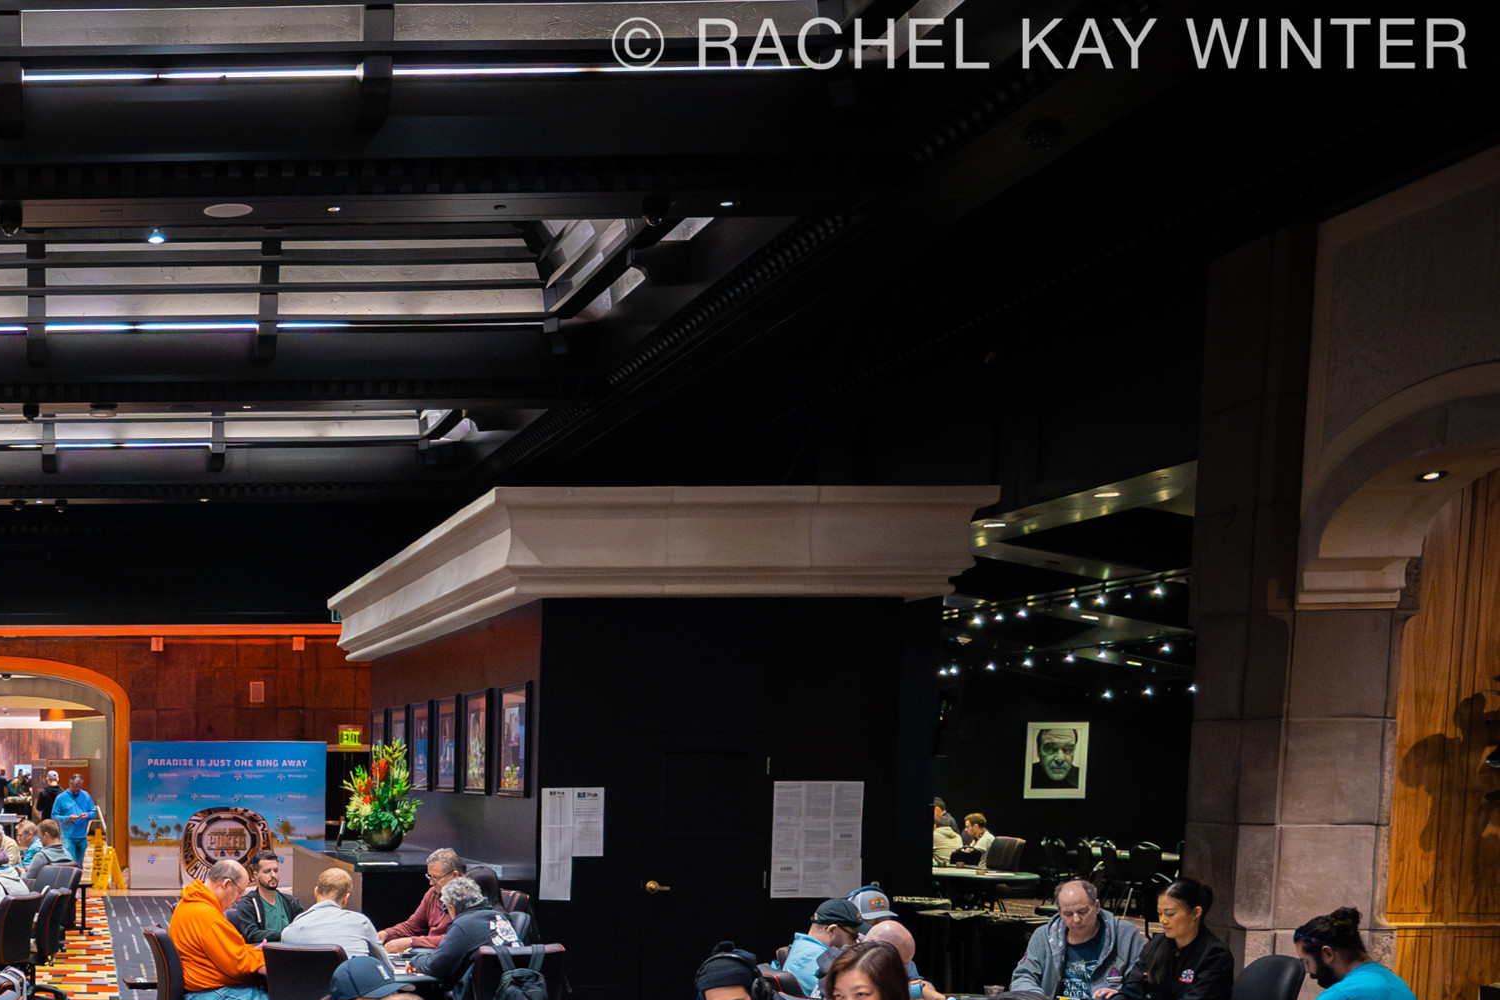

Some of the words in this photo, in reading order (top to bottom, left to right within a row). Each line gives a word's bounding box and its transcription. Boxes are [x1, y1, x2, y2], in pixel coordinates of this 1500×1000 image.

[342, 730, 360, 744] EXIT
[147, 758, 194, 767] PARADISE
[196, 759, 206, 767] IS
[207, 759, 231, 767] JUST
[234, 759, 253, 767] ONE
[256, 759, 279, 767] RING
[281, 759, 308, 767] AWAY
